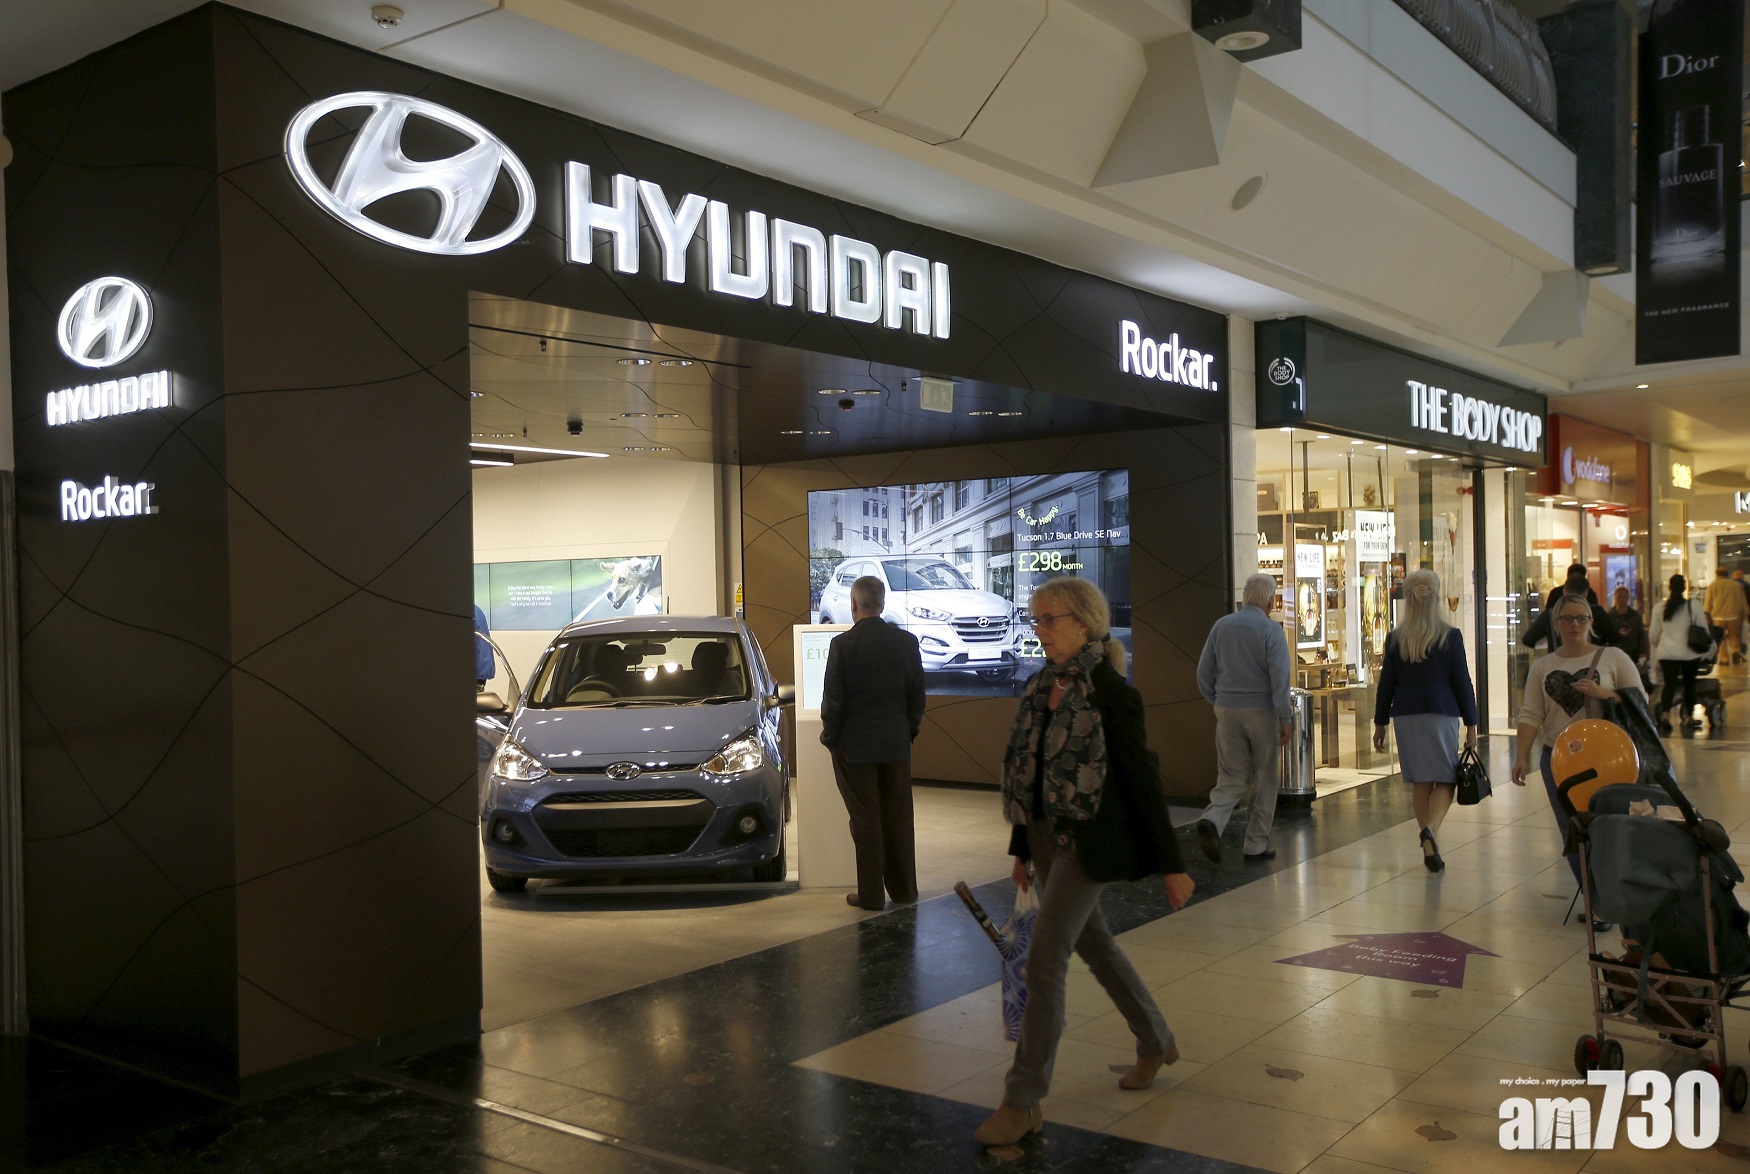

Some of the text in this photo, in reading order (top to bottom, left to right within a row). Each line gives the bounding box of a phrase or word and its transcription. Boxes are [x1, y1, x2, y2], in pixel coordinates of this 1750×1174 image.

[1658, 53, 1719, 80] Dior
[1659, 169, 1717, 189] SAUVAGE
[565, 160, 951, 340] HYUNDAI
[1681, 301, 1730, 312] FRAGRANCE
[1119, 319, 1218, 392] Rockar.
[1273, 369, 1291, 377] BODY
[46, 370, 173, 427] HYUNDAI
[1406, 380, 1542, 453] THE BODY SHOP
[1017, 507, 1026, 520] Be
[1025, 516, 1037, 527] Car
[1017, 533, 1042, 542] Tucson
[1045, 532, 1054, 541] 1.7
[1056, 531, 1072, 540] Blue
[1073, 530, 1093, 540] Drive
[1094, 530, 1104, 539] SE
[1018, 551, 1083, 573] £298 MONTH
[1348, 944, 1457, 962] Baby Feeding
[1355, 954, 1421, 967] this way
[1372, 951, 1418, 961] Room
